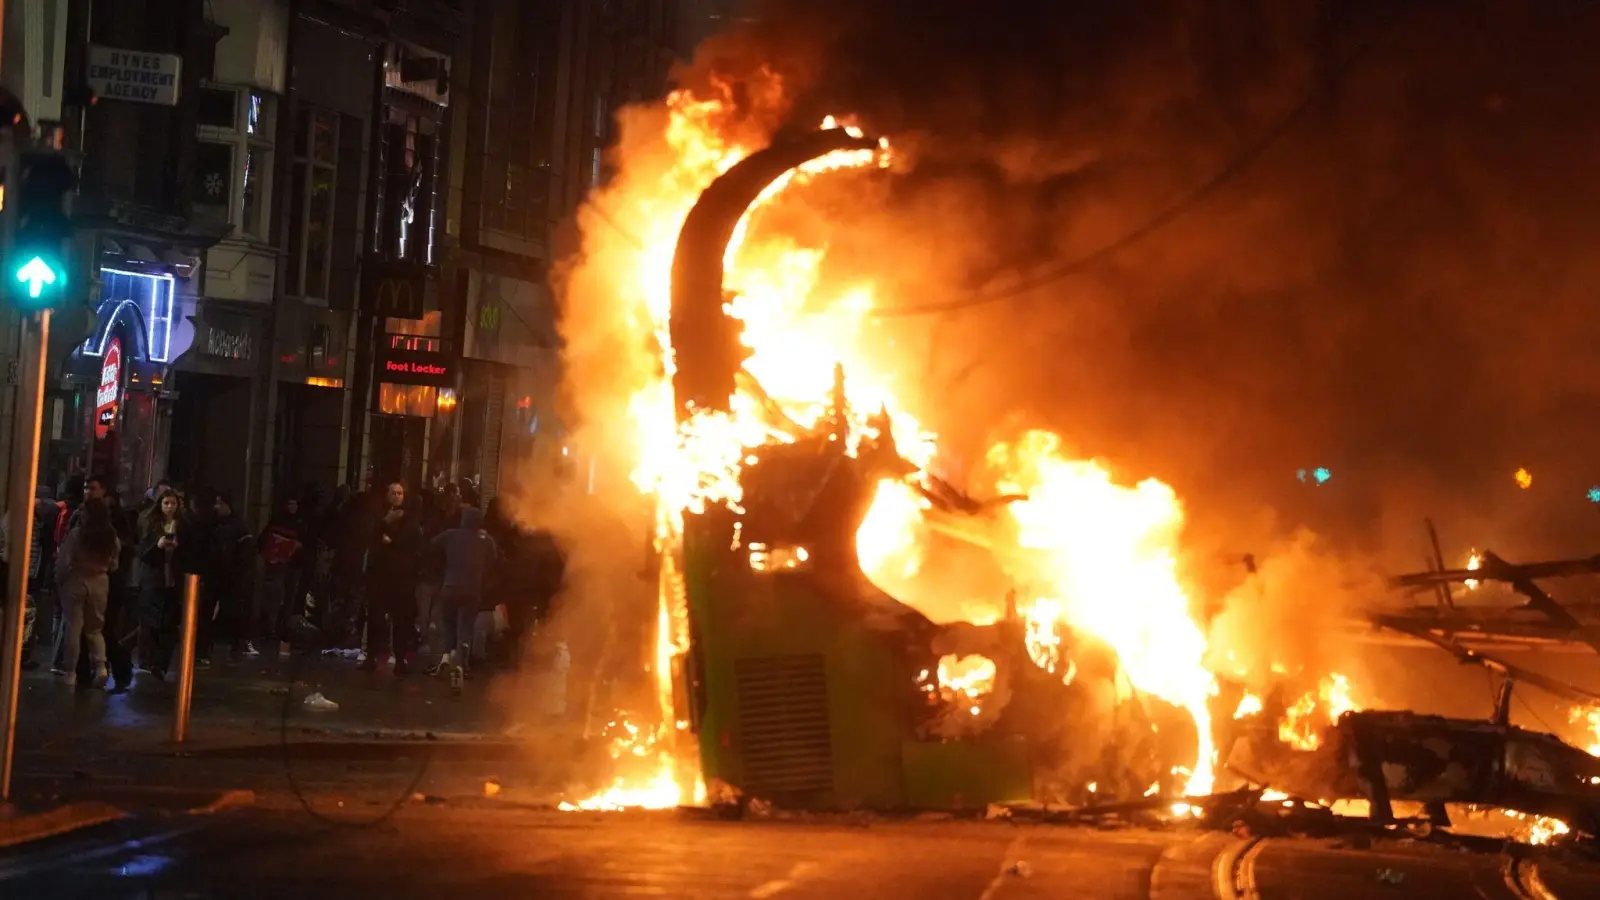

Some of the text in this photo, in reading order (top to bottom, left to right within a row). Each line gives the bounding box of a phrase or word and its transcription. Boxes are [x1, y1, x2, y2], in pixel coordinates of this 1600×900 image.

[110, 51, 161, 70] HYNES
[90, 65, 175, 86] EMPLOYMENT
[104, 82, 158, 101] AGENCY
[386, 360, 447, 375] Foot Locker
